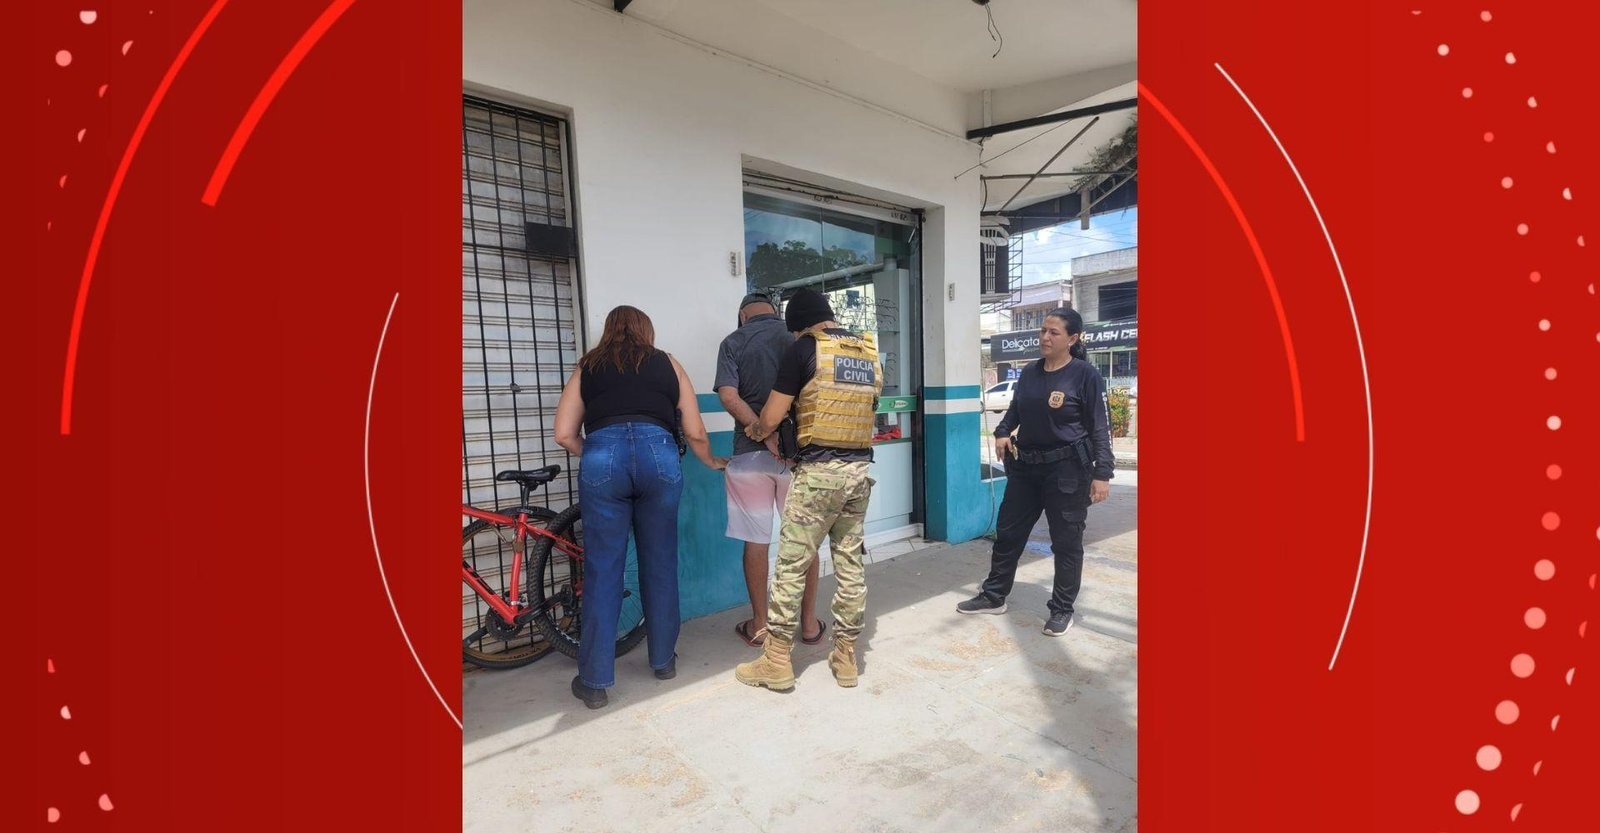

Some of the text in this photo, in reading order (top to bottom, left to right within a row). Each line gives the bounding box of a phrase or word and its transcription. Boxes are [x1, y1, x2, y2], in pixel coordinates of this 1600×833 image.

[1085, 330, 1119, 343] FLASH
[837, 357, 873, 371] POLICIA
[844, 370, 870, 382] CIVIL
